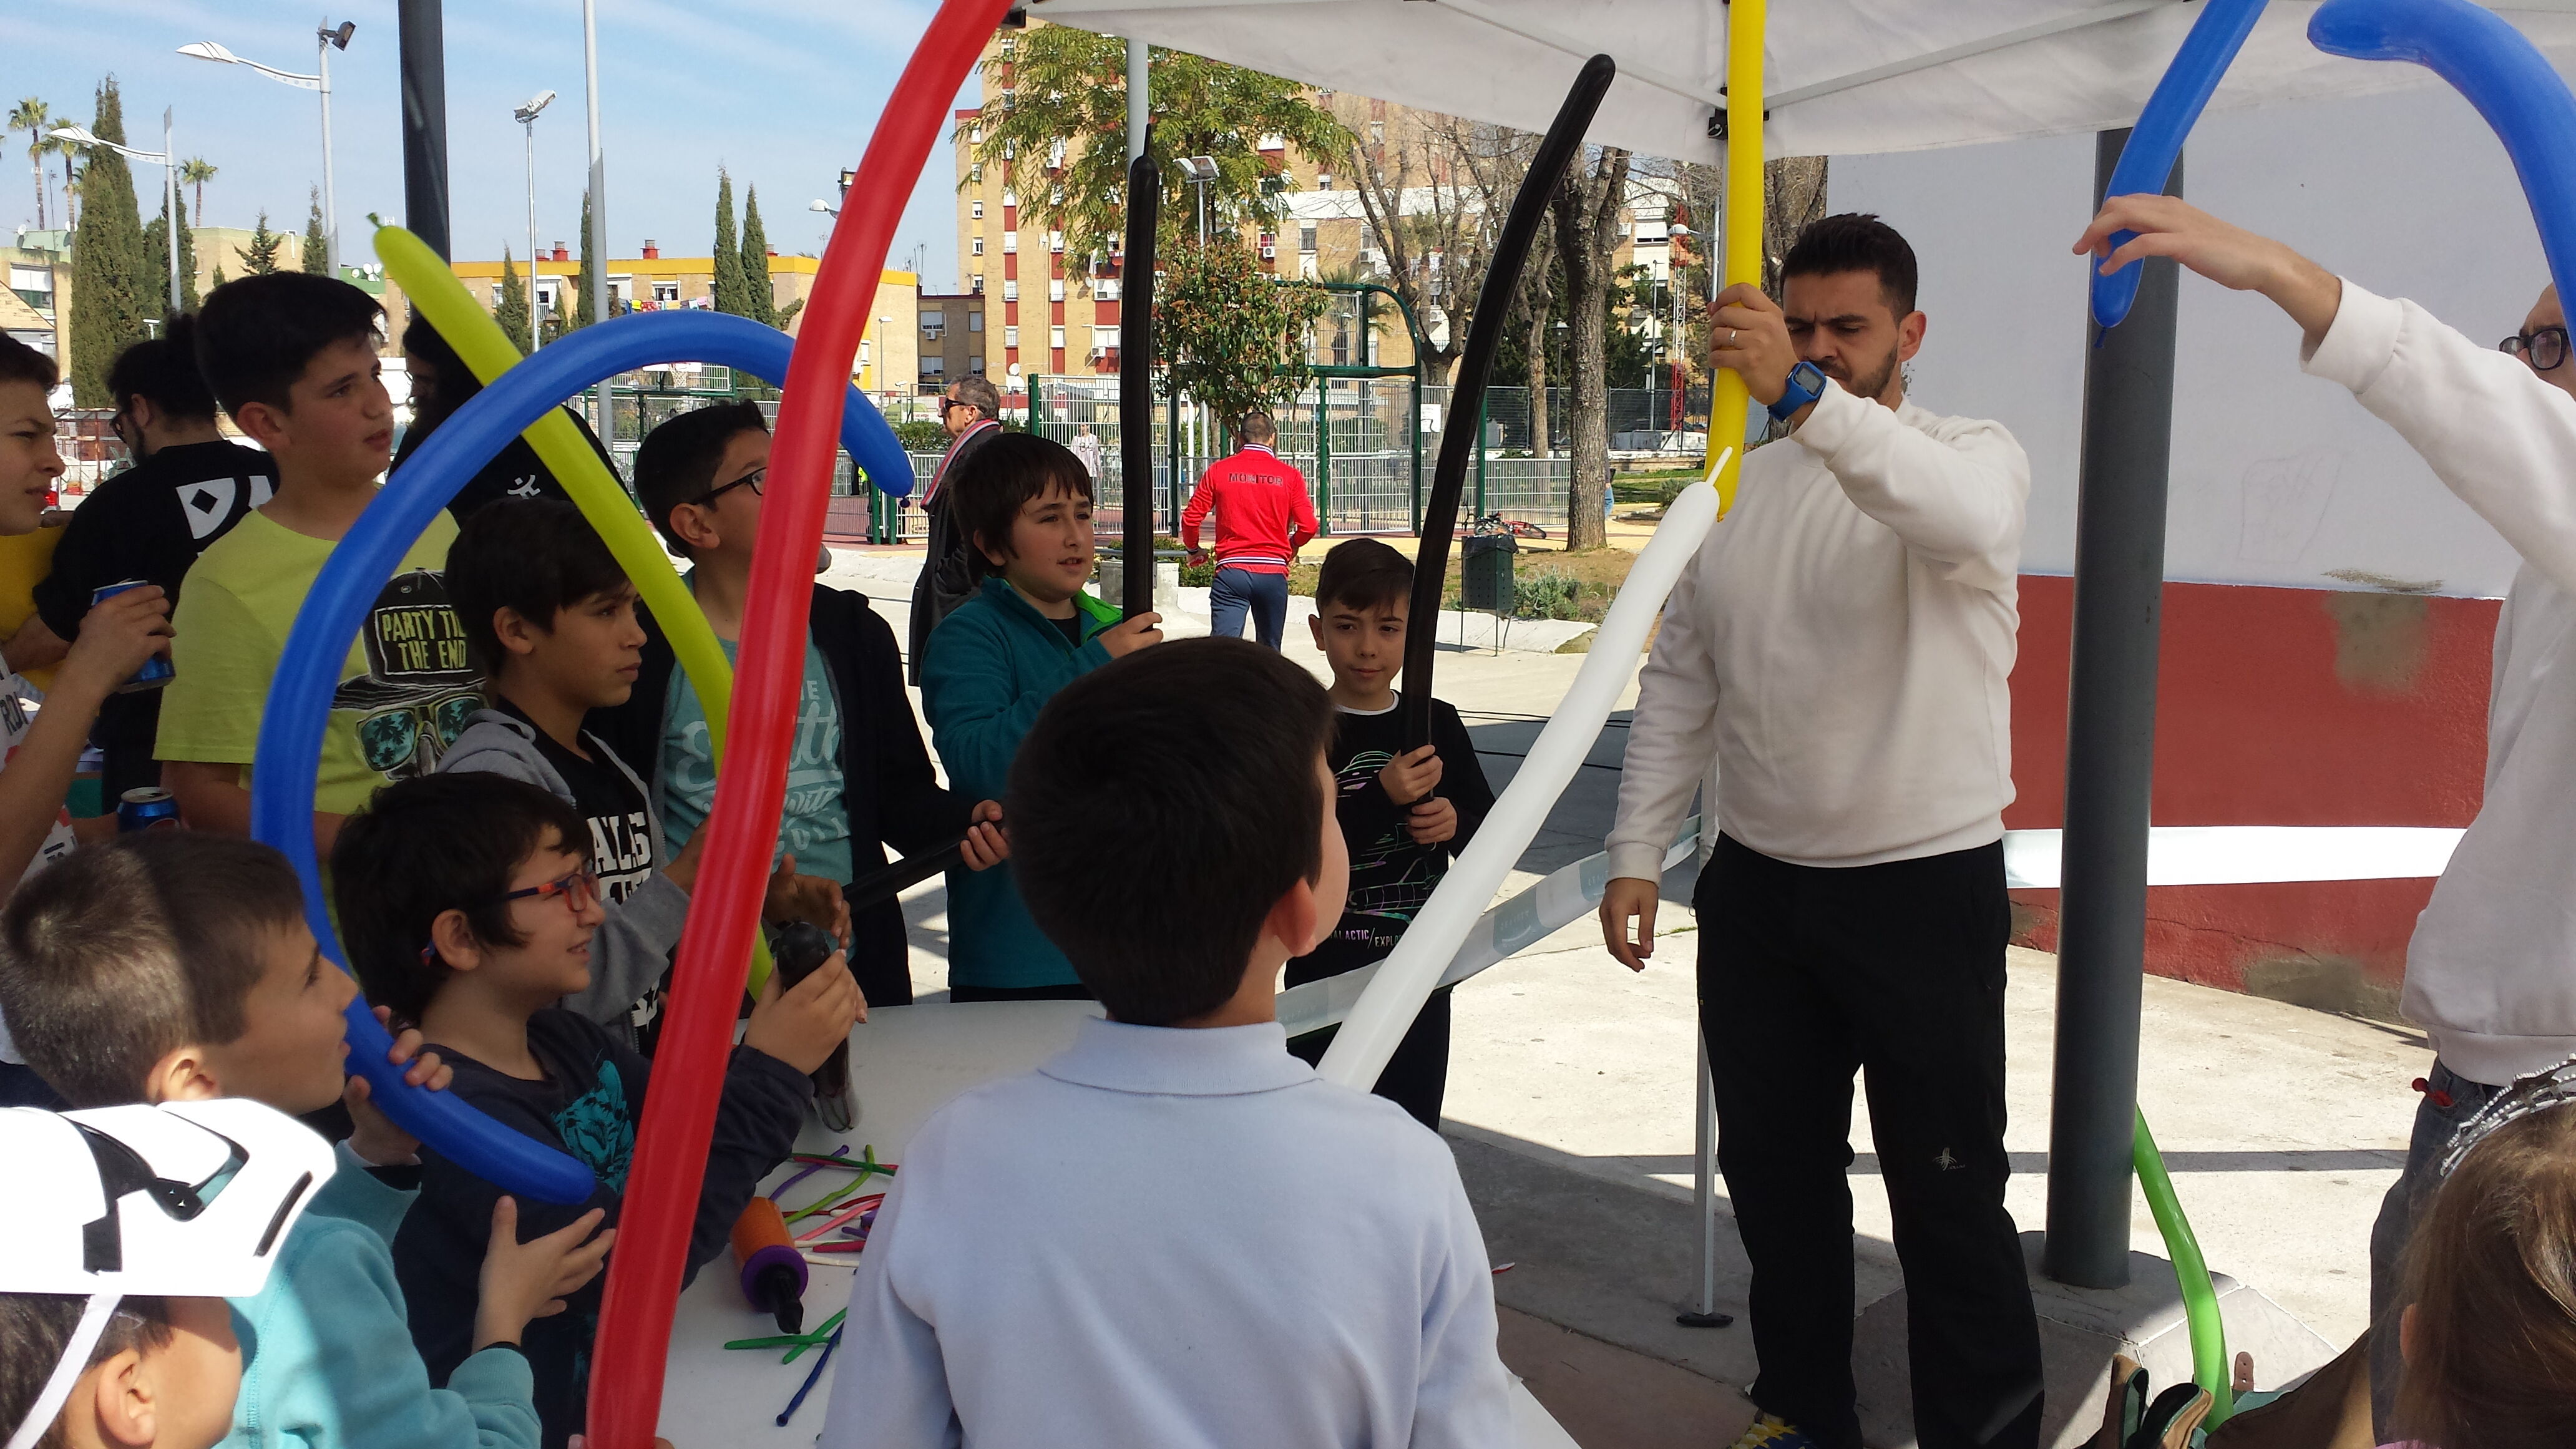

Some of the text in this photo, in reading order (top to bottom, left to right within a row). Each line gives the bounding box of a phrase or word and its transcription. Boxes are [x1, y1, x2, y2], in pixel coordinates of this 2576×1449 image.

[1228, 472, 1284, 486] MONITOR
[381, 609, 436, 642] PARTY
[398, 639, 467, 671] THE END
